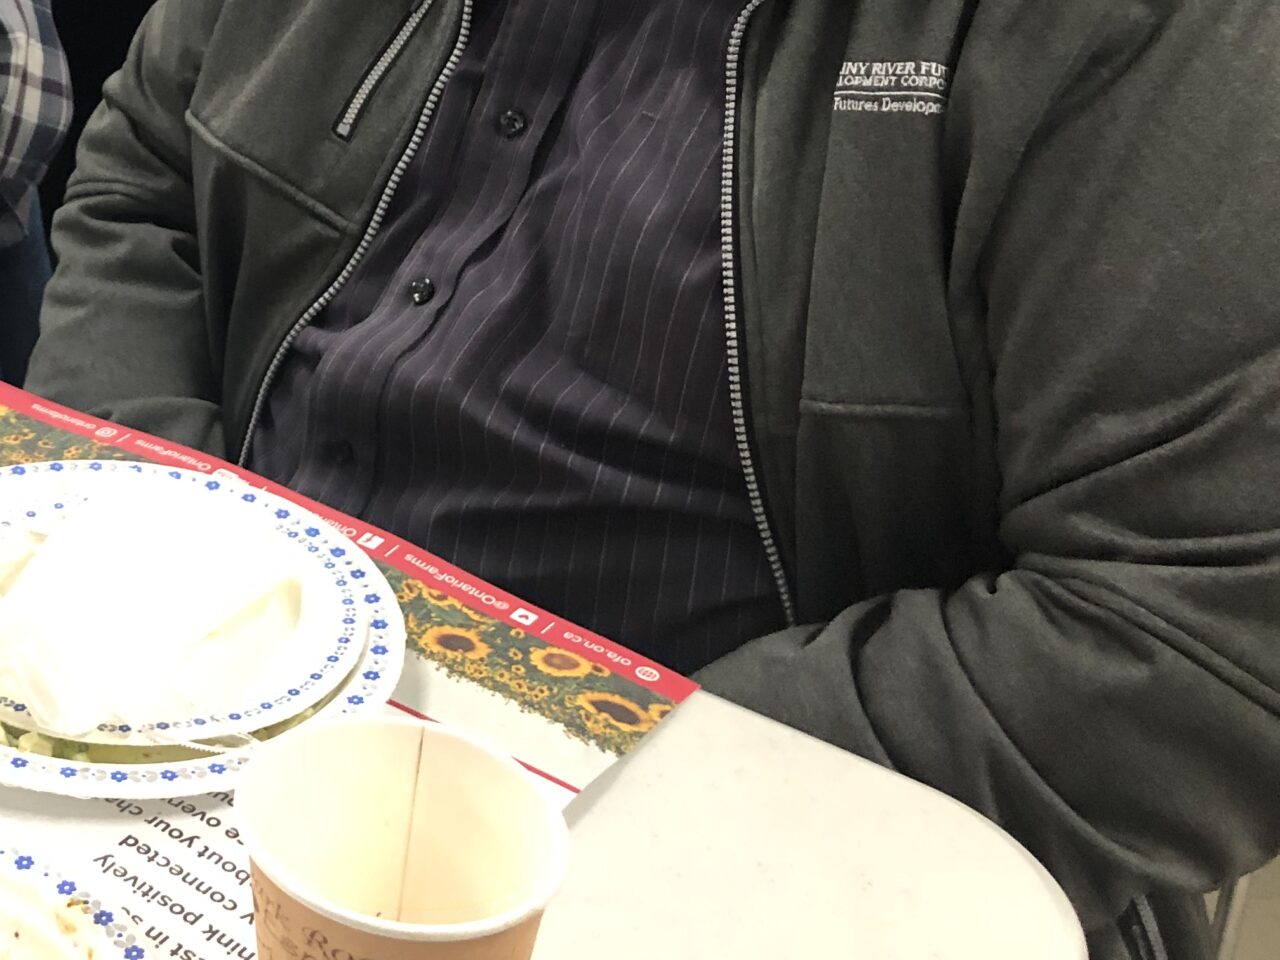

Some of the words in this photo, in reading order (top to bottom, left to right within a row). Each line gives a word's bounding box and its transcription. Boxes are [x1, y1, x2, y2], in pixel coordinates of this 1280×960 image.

[836, 75, 898, 87] LOPMENT
[839, 61, 871, 75] INY
[871, 61, 916, 75] RIVER
[920, 60, 948, 76] FUT
[833, 96, 879, 111] Futures
[881, 96, 943, 116] Develop
[402, 552, 511, 612] @OntarioFarms
[561, 630, 633, 668] ofa.on.ca
[144, 815, 201, 849] your
[117, 834, 238, 912] connected
[196, 845, 253, 887] bout
[92, 853, 204, 926] positively
[144, 925, 170, 950] in
[201, 923, 257, 960] hink
